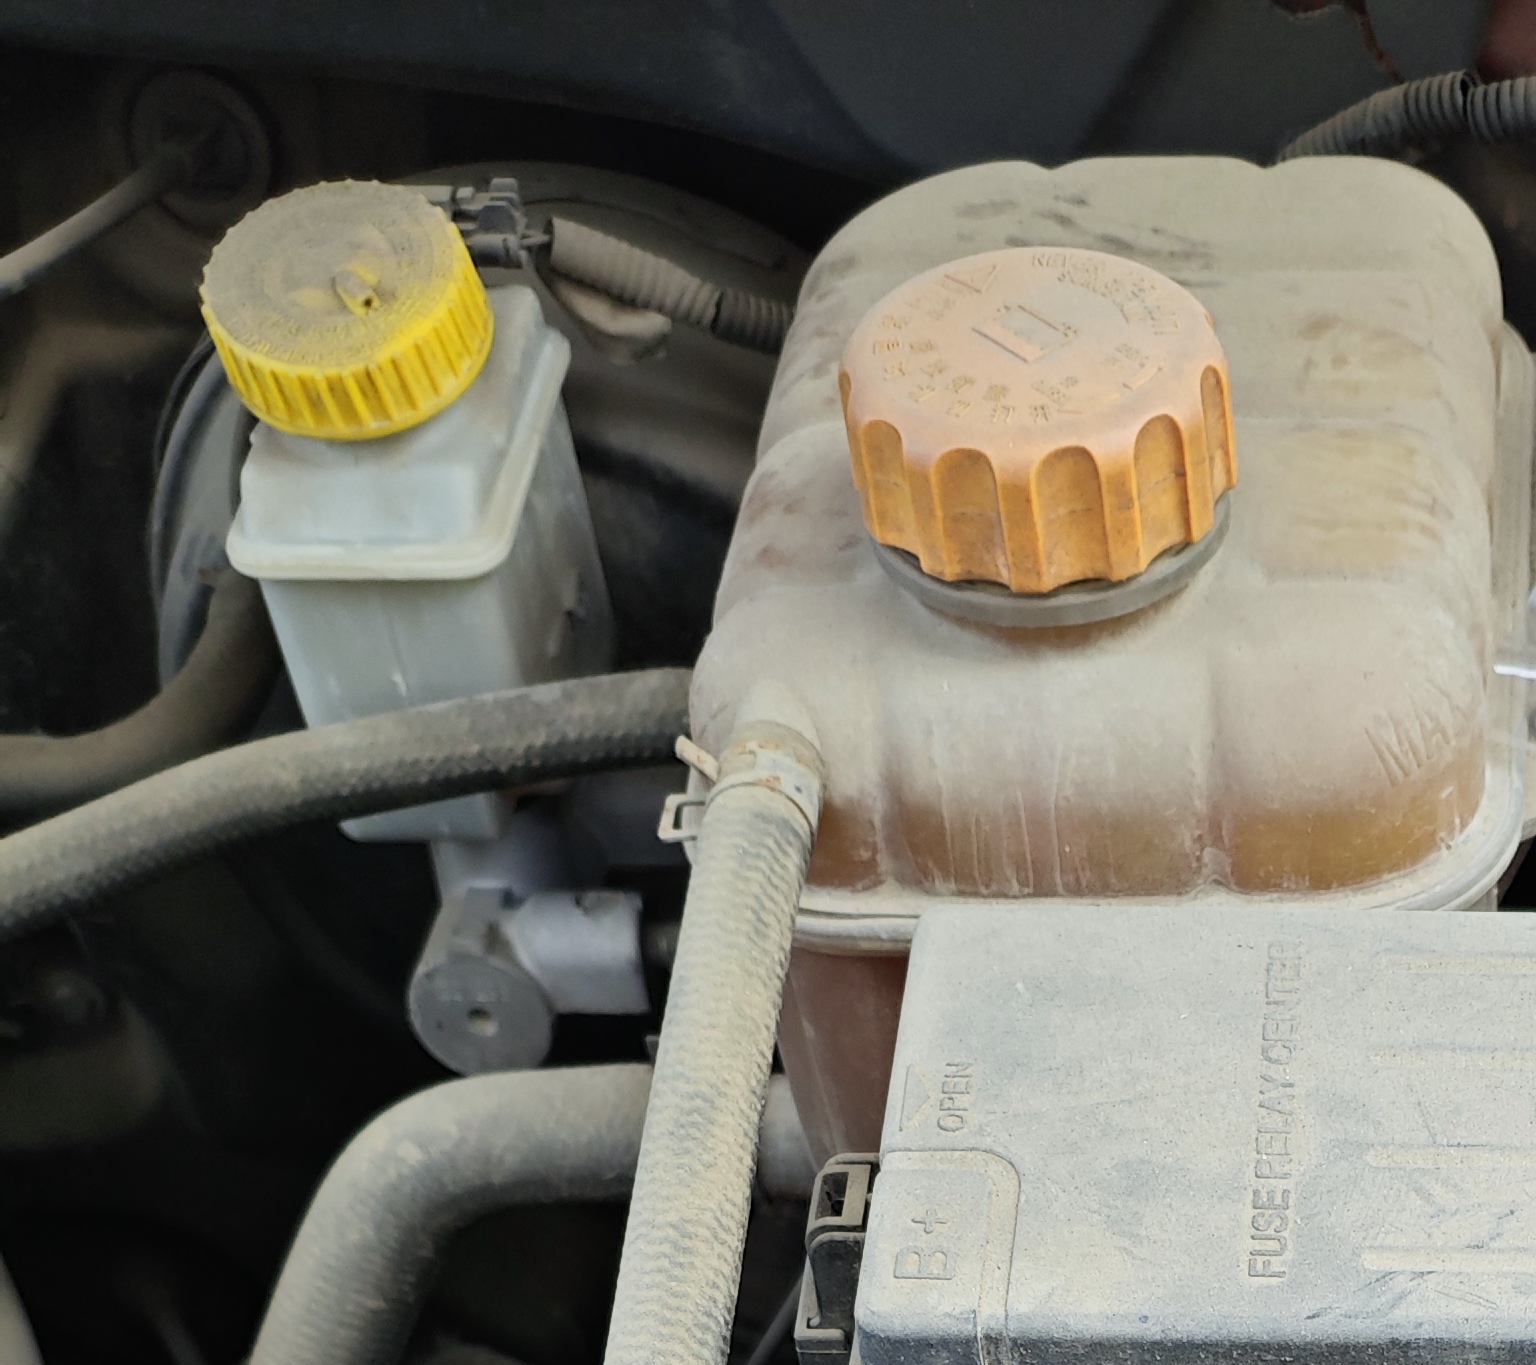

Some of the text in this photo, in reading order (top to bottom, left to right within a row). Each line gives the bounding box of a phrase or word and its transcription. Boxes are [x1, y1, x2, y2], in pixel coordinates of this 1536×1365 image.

[936, 1060, 975, 1134] OPEN
[1247, 940, 1302, 1279] FUSE RELAY CENTER
